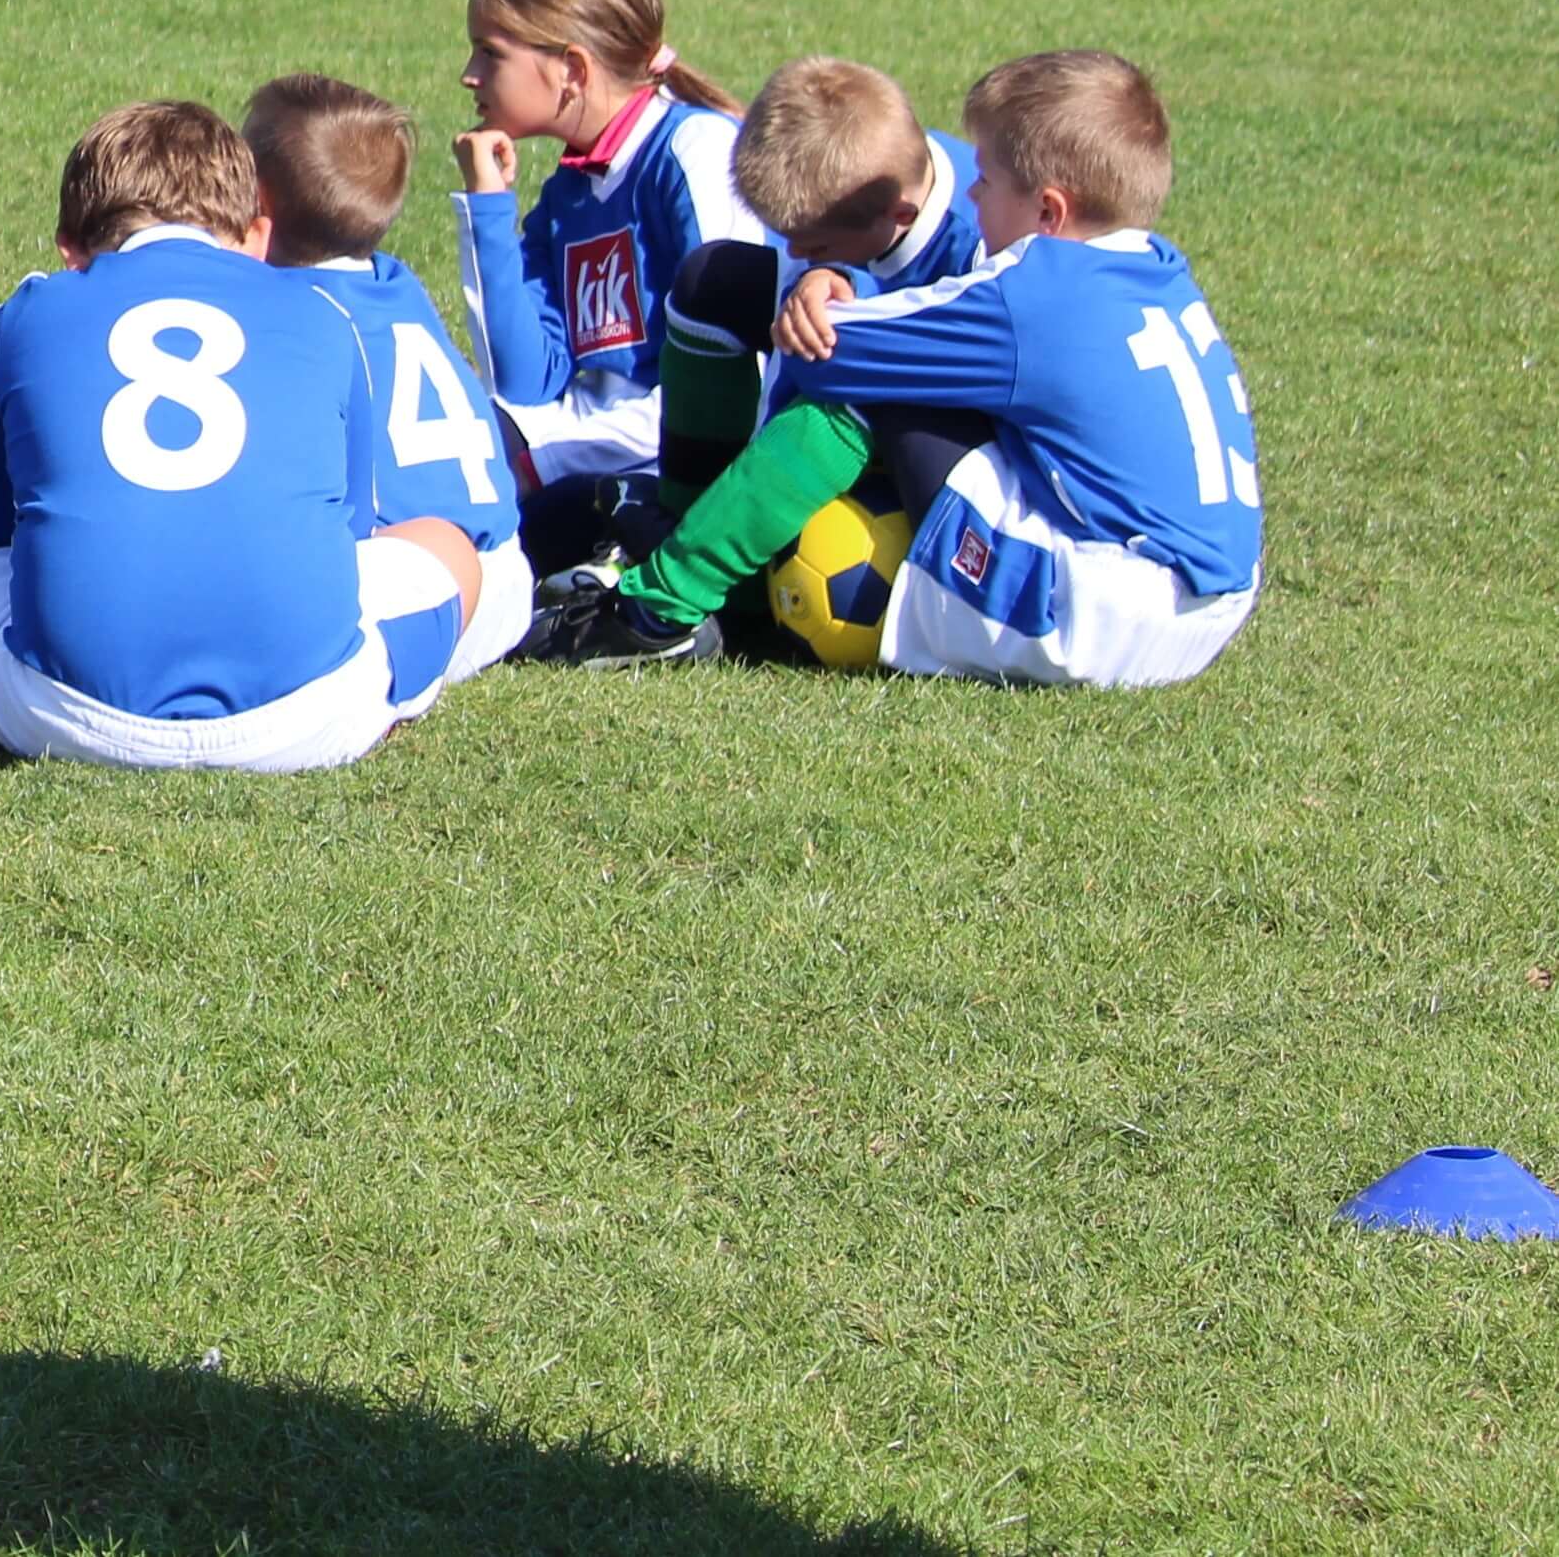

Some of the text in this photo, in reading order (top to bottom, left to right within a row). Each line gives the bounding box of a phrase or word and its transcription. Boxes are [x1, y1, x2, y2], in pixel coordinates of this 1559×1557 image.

[576, 240, 631, 332] kik
[102, 298, 247, 490] 8
[388, 322, 499, 505] 4
